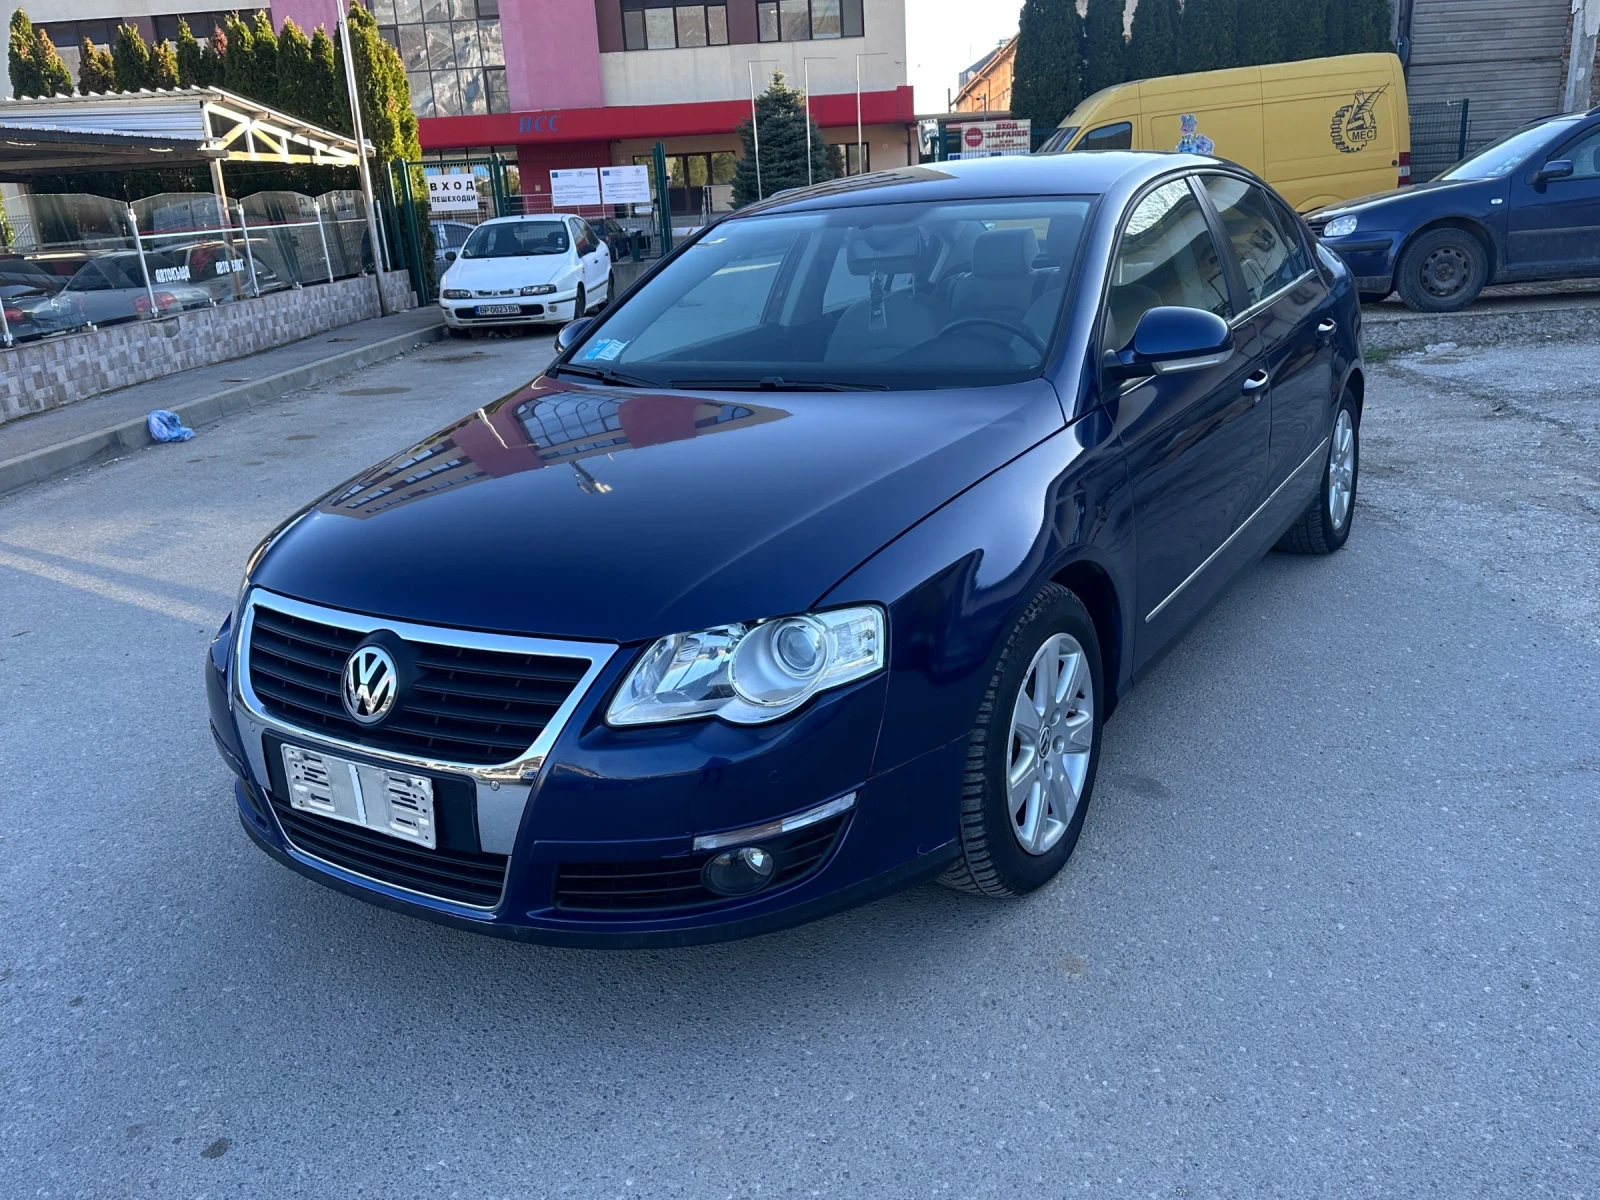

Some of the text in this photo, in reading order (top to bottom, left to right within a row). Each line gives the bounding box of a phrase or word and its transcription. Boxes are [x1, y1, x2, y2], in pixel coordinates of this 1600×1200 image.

[986, 130, 1028, 139] ЗАБРАНЕН
[430, 181, 474, 191] ВХОД
[432, 195, 476, 203] ПЕШЕХОДЦИ
